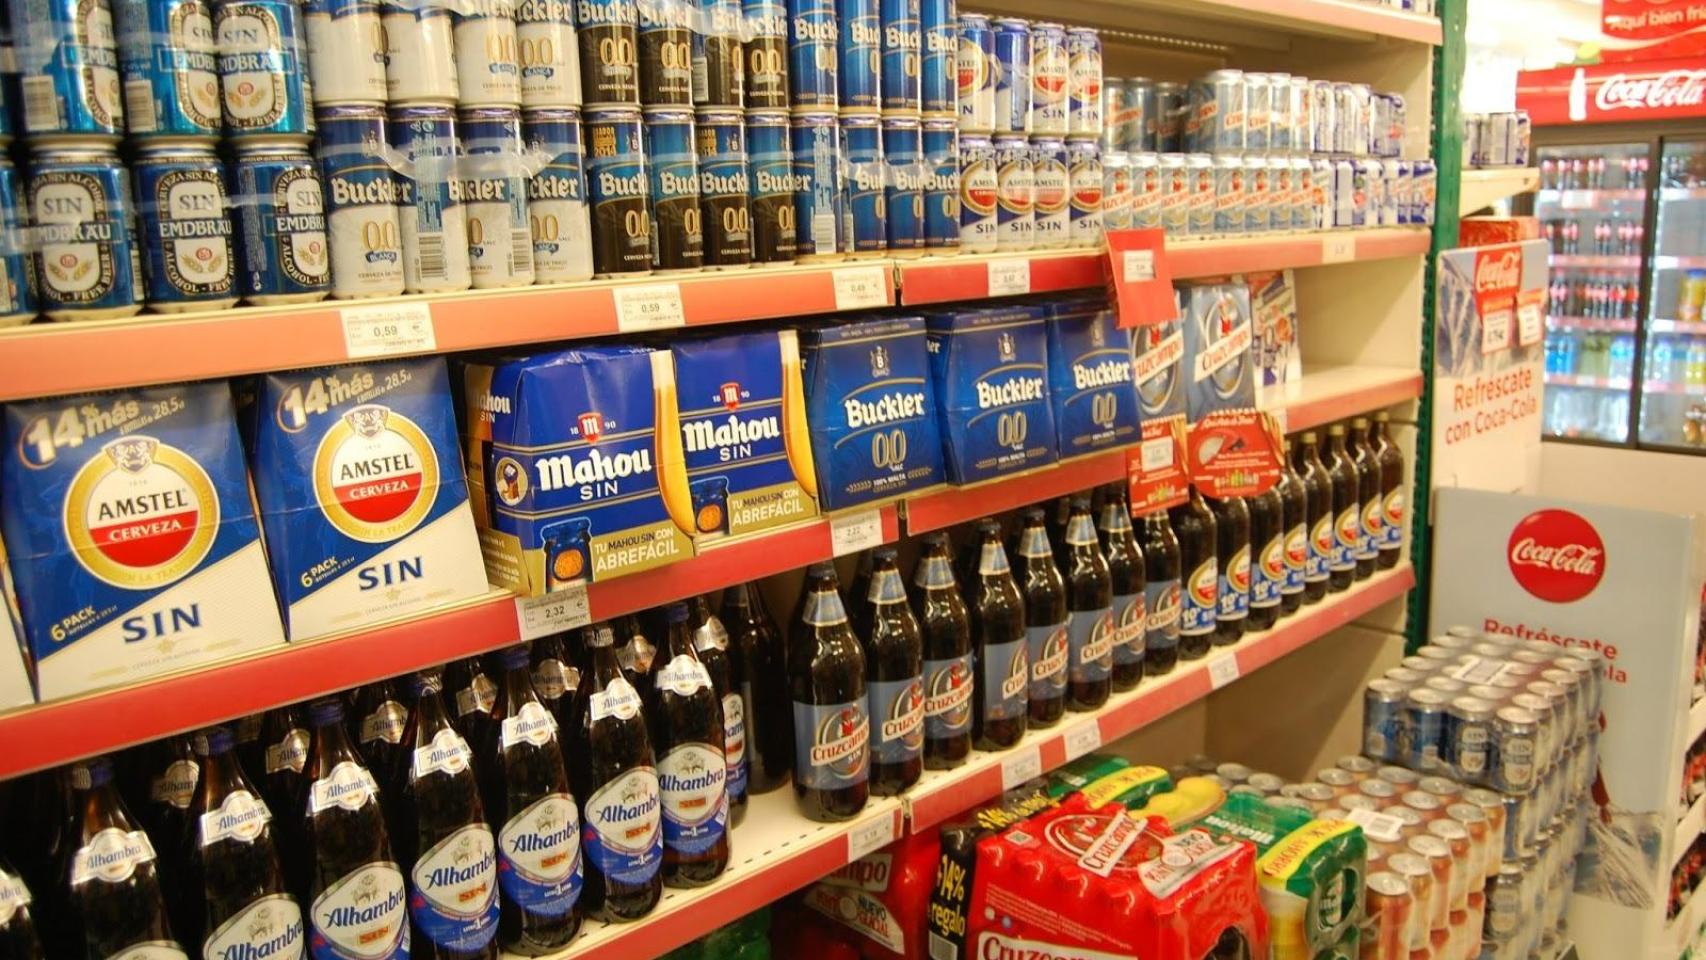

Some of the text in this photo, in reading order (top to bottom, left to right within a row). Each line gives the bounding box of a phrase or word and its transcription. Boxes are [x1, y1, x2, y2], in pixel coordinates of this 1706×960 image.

[1652, 10, 1683, 25] bien
[1595, 69, 1706, 111] Coca-Cola
[1043, 108, 1065, 119] SIN
[43, 198, 83, 214] SIN
[180, 194, 214, 210] SIN
[295, 190, 321, 208] SIN
[1036, 221, 1062, 231] SIN
[1073, 360, 1130, 389] Buckler
[977, 376, 1043, 409] Buckler
[1453, 369, 1532, 412] Refréscate
[845, 392, 925, 428] Buckler
[1445, 396, 1537, 445] con Coca-Cola
[605, 420, 616, 430] 90
[683, 415, 779, 452] Mahou
[720, 444, 751, 461] SIN
[339, 453, 414, 481] AMSTEL
[535, 449, 652, 491] Mahou
[350, 480, 409, 500] CERVEZA
[580, 481, 619, 500] SIN
[732, 489, 799, 510] TU MAHOU SIN CON
[98, 489, 189, 521] AMSTEL
[732, 499, 804, 526] ABREFÁCIL
[109, 519, 182, 542] CERVEZA
[595, 528, 674, 554] TU MAHOU SIN CON
[596, 540, 679, 572] ABREFÁCIL
[1511, 537, 1601, 576] Coca-Cola
[301, 555, 338, 588] 6 PACK
[358, 556, 423, 592] SIN
[51, 606, 97, 641] 6 PACK
[122, 603, 201, 644] SIN
[659, 770, 724, 791] Alhambra
[86, 845, 142, 869] Alhambra
[931, 903, 965, 937] regalo
